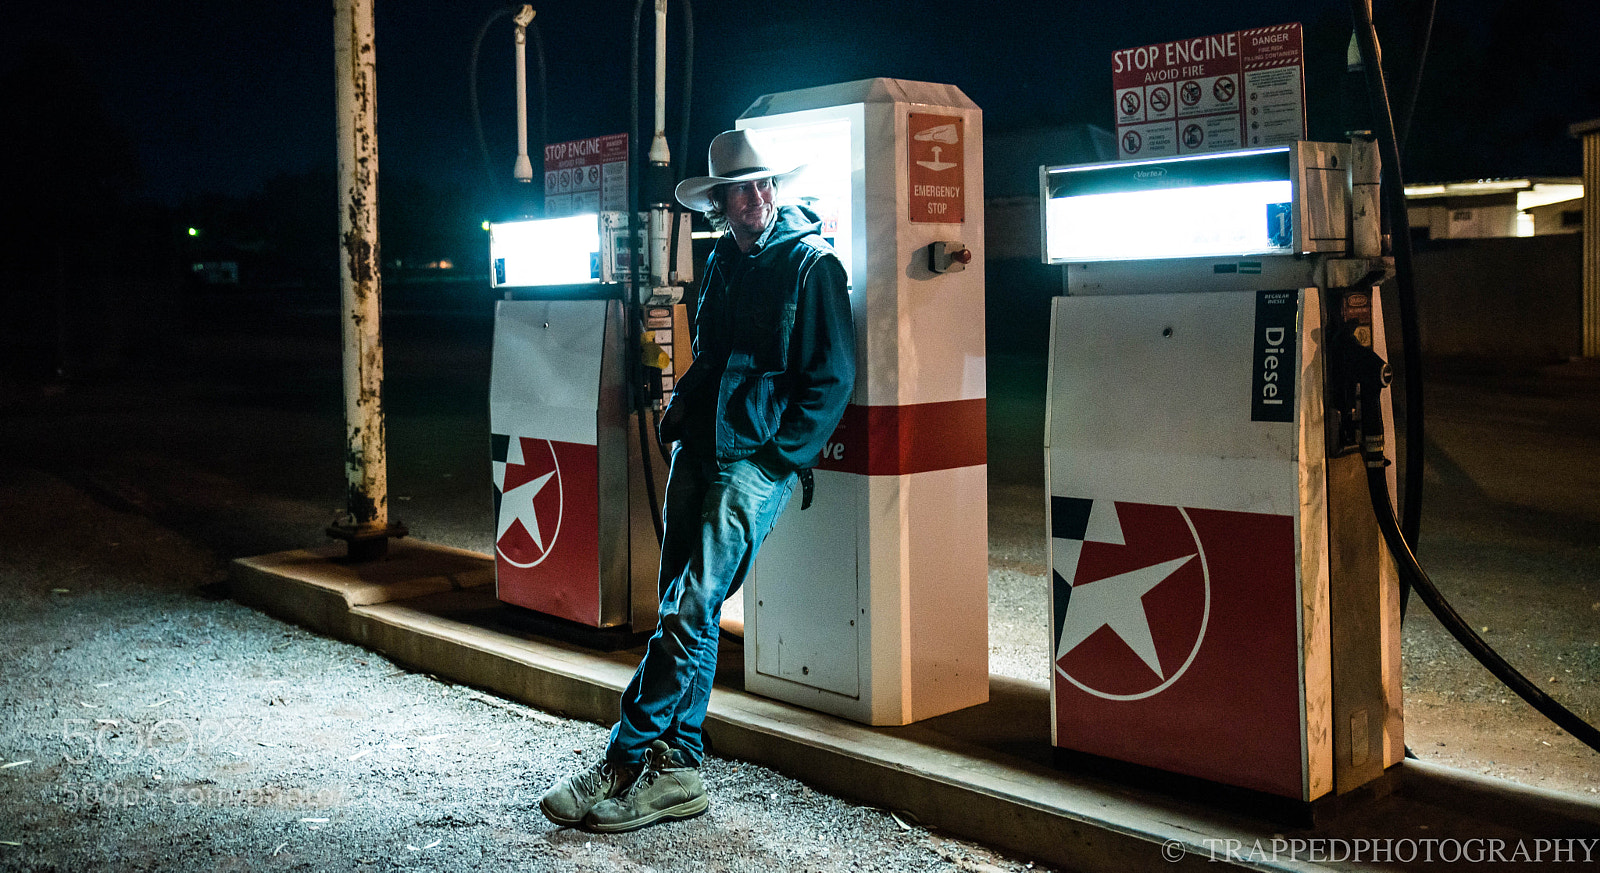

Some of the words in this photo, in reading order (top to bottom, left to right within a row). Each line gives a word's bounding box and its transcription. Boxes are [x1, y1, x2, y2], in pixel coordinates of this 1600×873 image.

[1252, 33, 1289, 46] DANGER
[1114, 46, 1159, 73] STOP
[1165, 33, 1238, 65] ENGINE
[1265, 49, 1299, 60] CONTAINERS
[1144, 68, 1178, 83] AVOID
[1182, 64, 1205, 78] FIRE
[545, 144, 567, 161] STOP
[568, 138, 600, 157] ENGINE
[1136, 169, 1163, 178] Vortex
[914, 184, 960, 198] EMERGENCY
[927, 203, 948, 215] STOP
[1275, 212, 1286, 237] 1
[592, 256, 600, 272] 2
[1262, 327, 1285, 404] Diesel
[822, 442, 845, 461] ve
